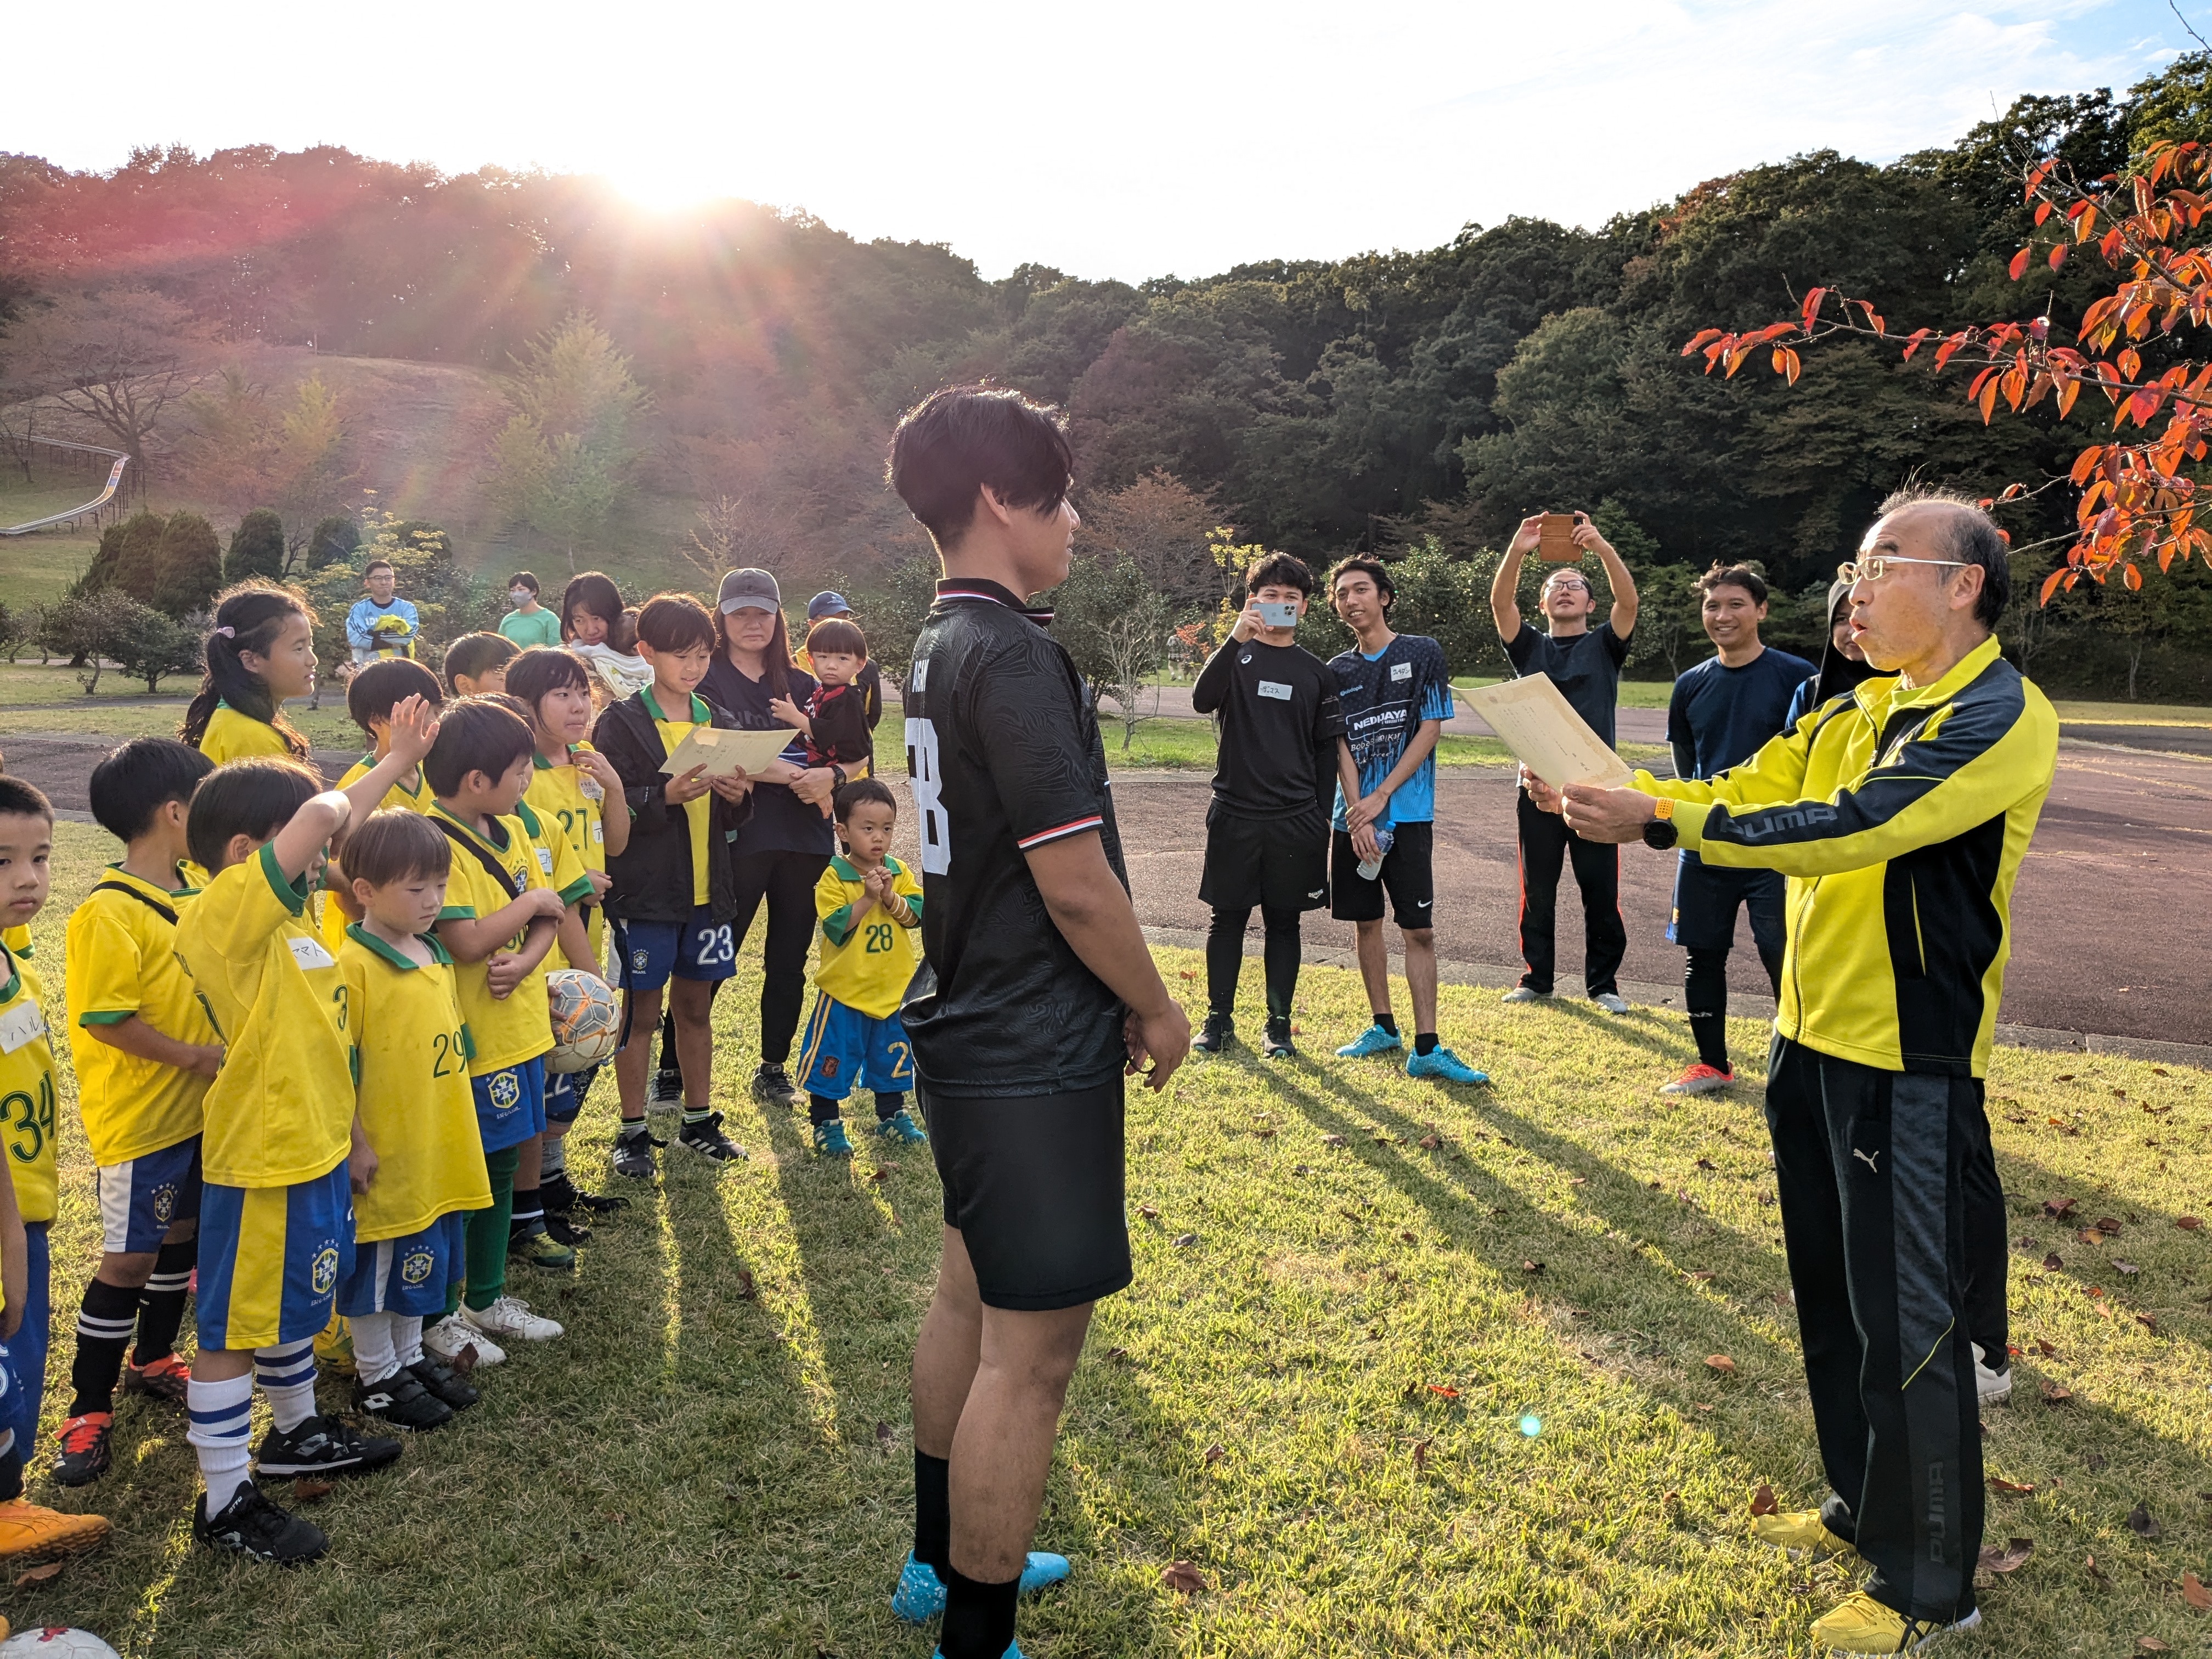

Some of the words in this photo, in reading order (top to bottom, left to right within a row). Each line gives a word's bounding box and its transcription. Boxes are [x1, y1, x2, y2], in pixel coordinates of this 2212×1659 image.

[557, 808, 588, 851] 27
[1720, 806, 1837, 838] PUMA
[697, 924, 734, 965] 23
[865, 923, 893, 953] 28
[11, 1016, 39, 1041] ハル
[433, 1031, 466, 1079] 29
[887, 1041, 911, 1078] 2
[0, 1070, 54, 1163] 34
[496, 1106, 522, 1120] BRASIL
[1929, 1462, 1946, 1564] PUMA
